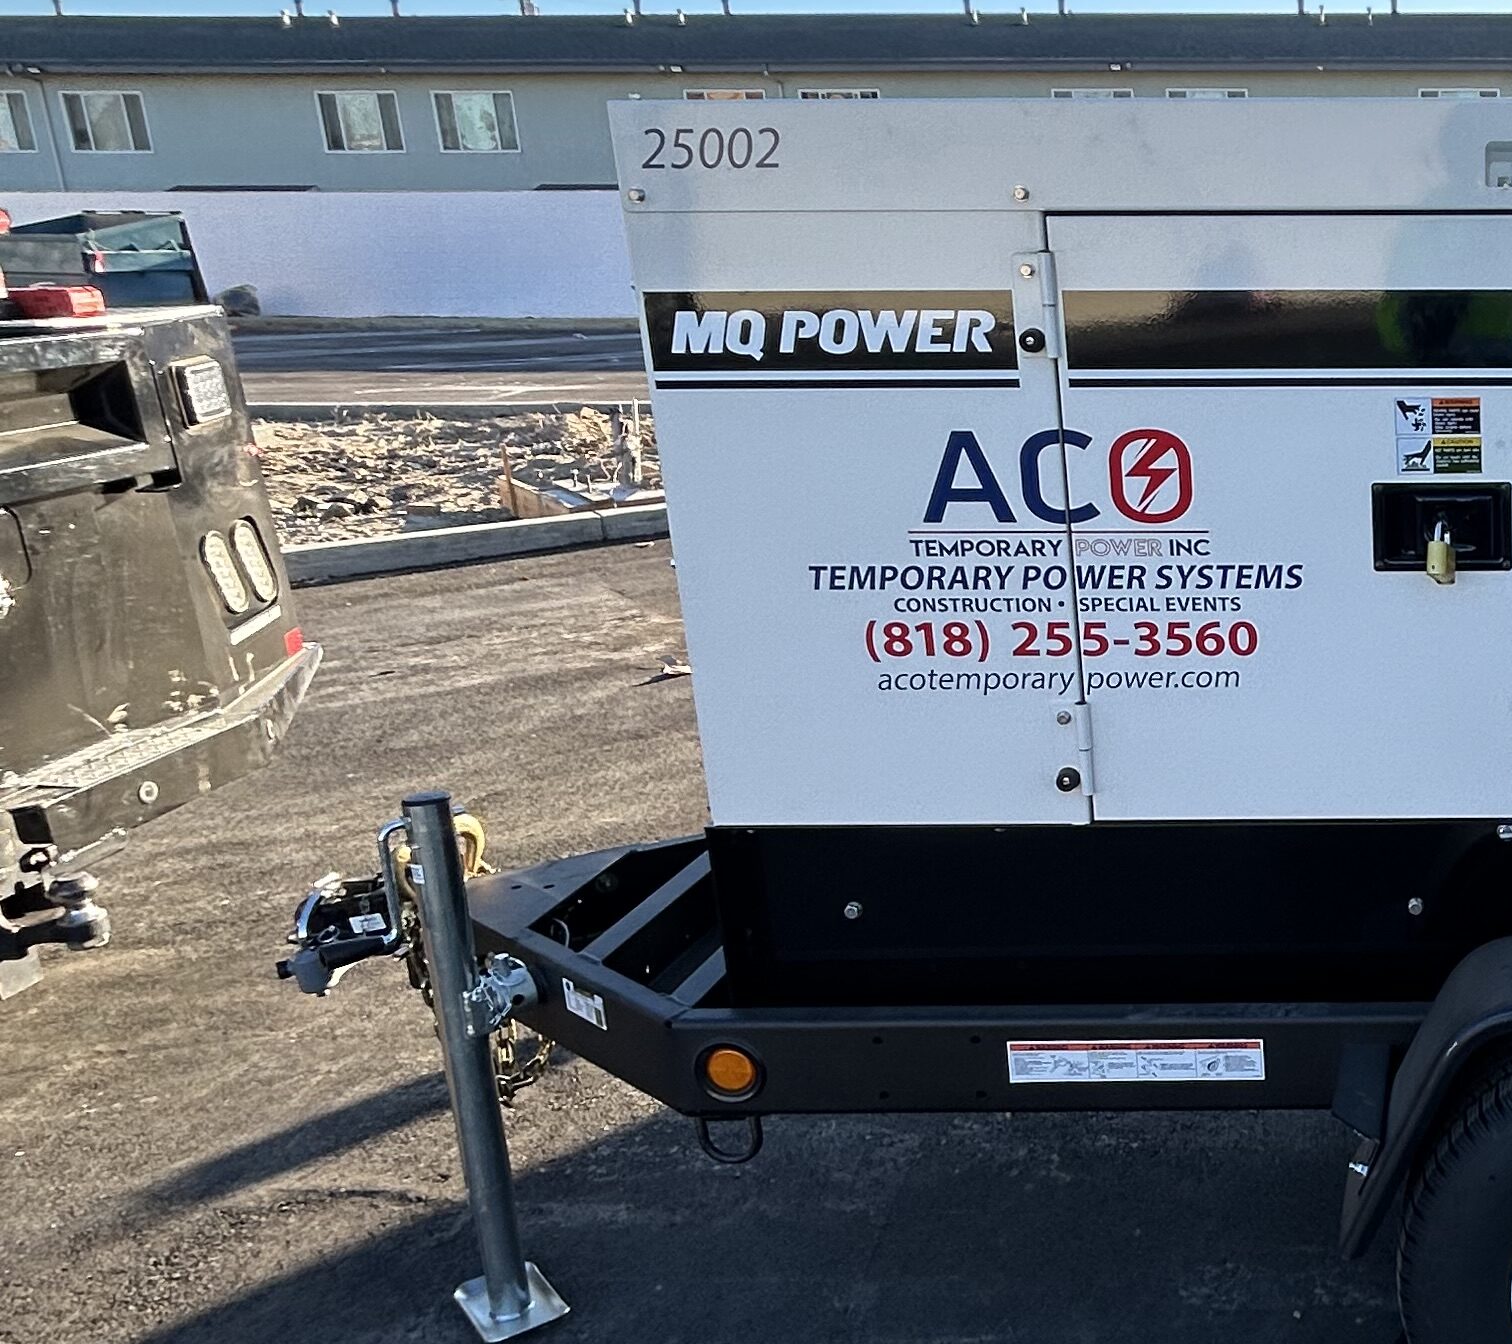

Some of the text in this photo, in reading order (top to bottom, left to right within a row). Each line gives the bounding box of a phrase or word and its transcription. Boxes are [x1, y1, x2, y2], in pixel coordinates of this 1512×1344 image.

[641, 127, 781, 169] 25002
[671, 309, 996, 361] MQ POWER
[923, 428, 1193, 524] ACO
[909, 539, 1210, 557] TEMPORARY POWER INC
[808, 565, 1015, 591] TEMPORARY
[1155, 564, 1304, 591] SYSTEMS
[894, 597, 1242, 613] CONSTRUCTION SPECIAL EVENTS
[865, 620, 1258, 663] (818) 255-3560
